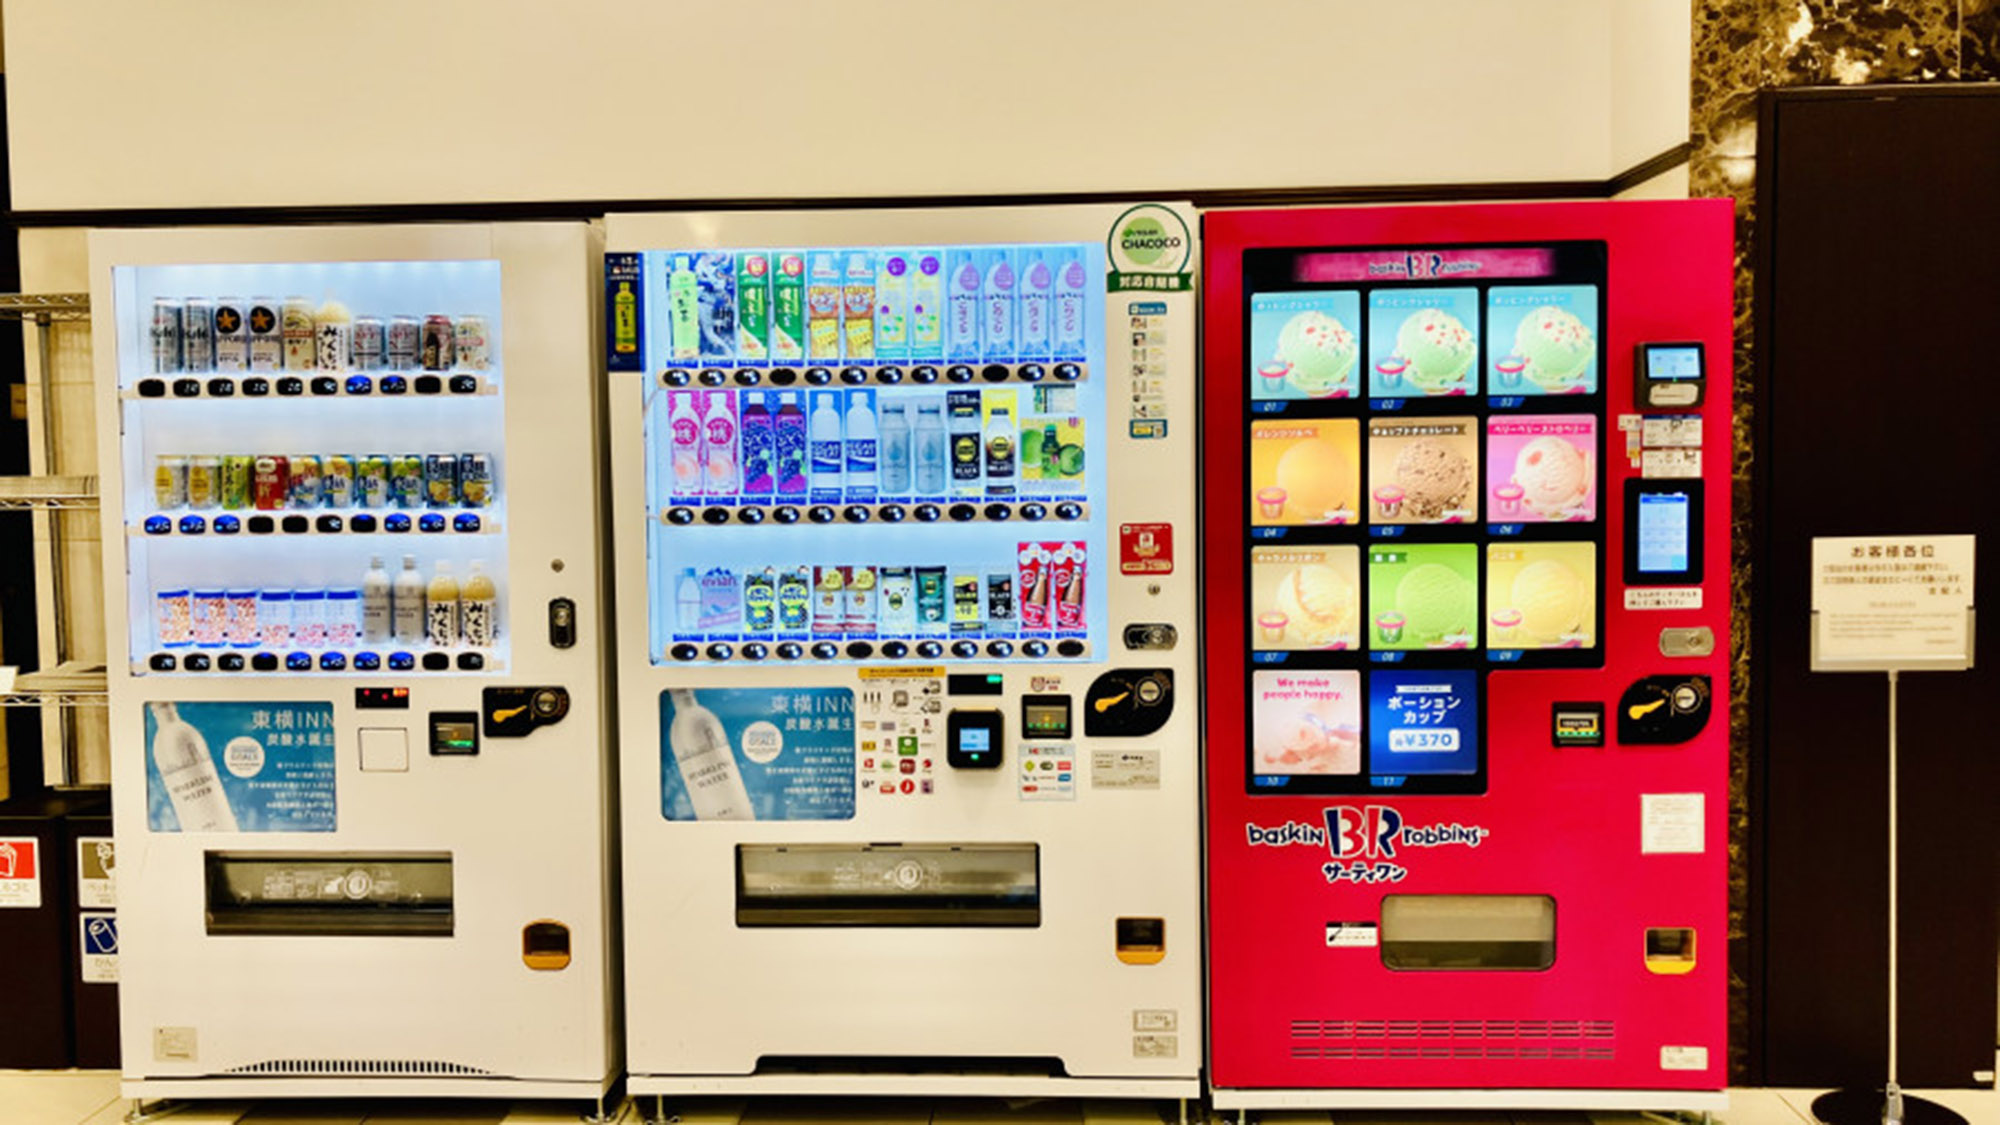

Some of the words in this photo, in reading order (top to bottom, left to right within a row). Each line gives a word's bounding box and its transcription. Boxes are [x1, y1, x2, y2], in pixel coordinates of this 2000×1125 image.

[1851, 545, 1935, 558] お客様各位
[1277, 678, 1295, 687] We
[1297, 678, 1330, 687] make
[770, 694, 854, 714] 東横INN
[1263, 691, 1302, 702] people
[1304, 690, 1343, 702] happy.
[1387, 695, 1461, 711] ポーション
[251, 709, 334, 731] 東横INN
[1403, 709, 1447, 725] カップ
[1246, 821, 1325, 847] baskin
[1322, 805, 1403, 858] BR
[1402, 822, 1482, 847] robbins
[1322, 861, 1408, 883] サーティワン
